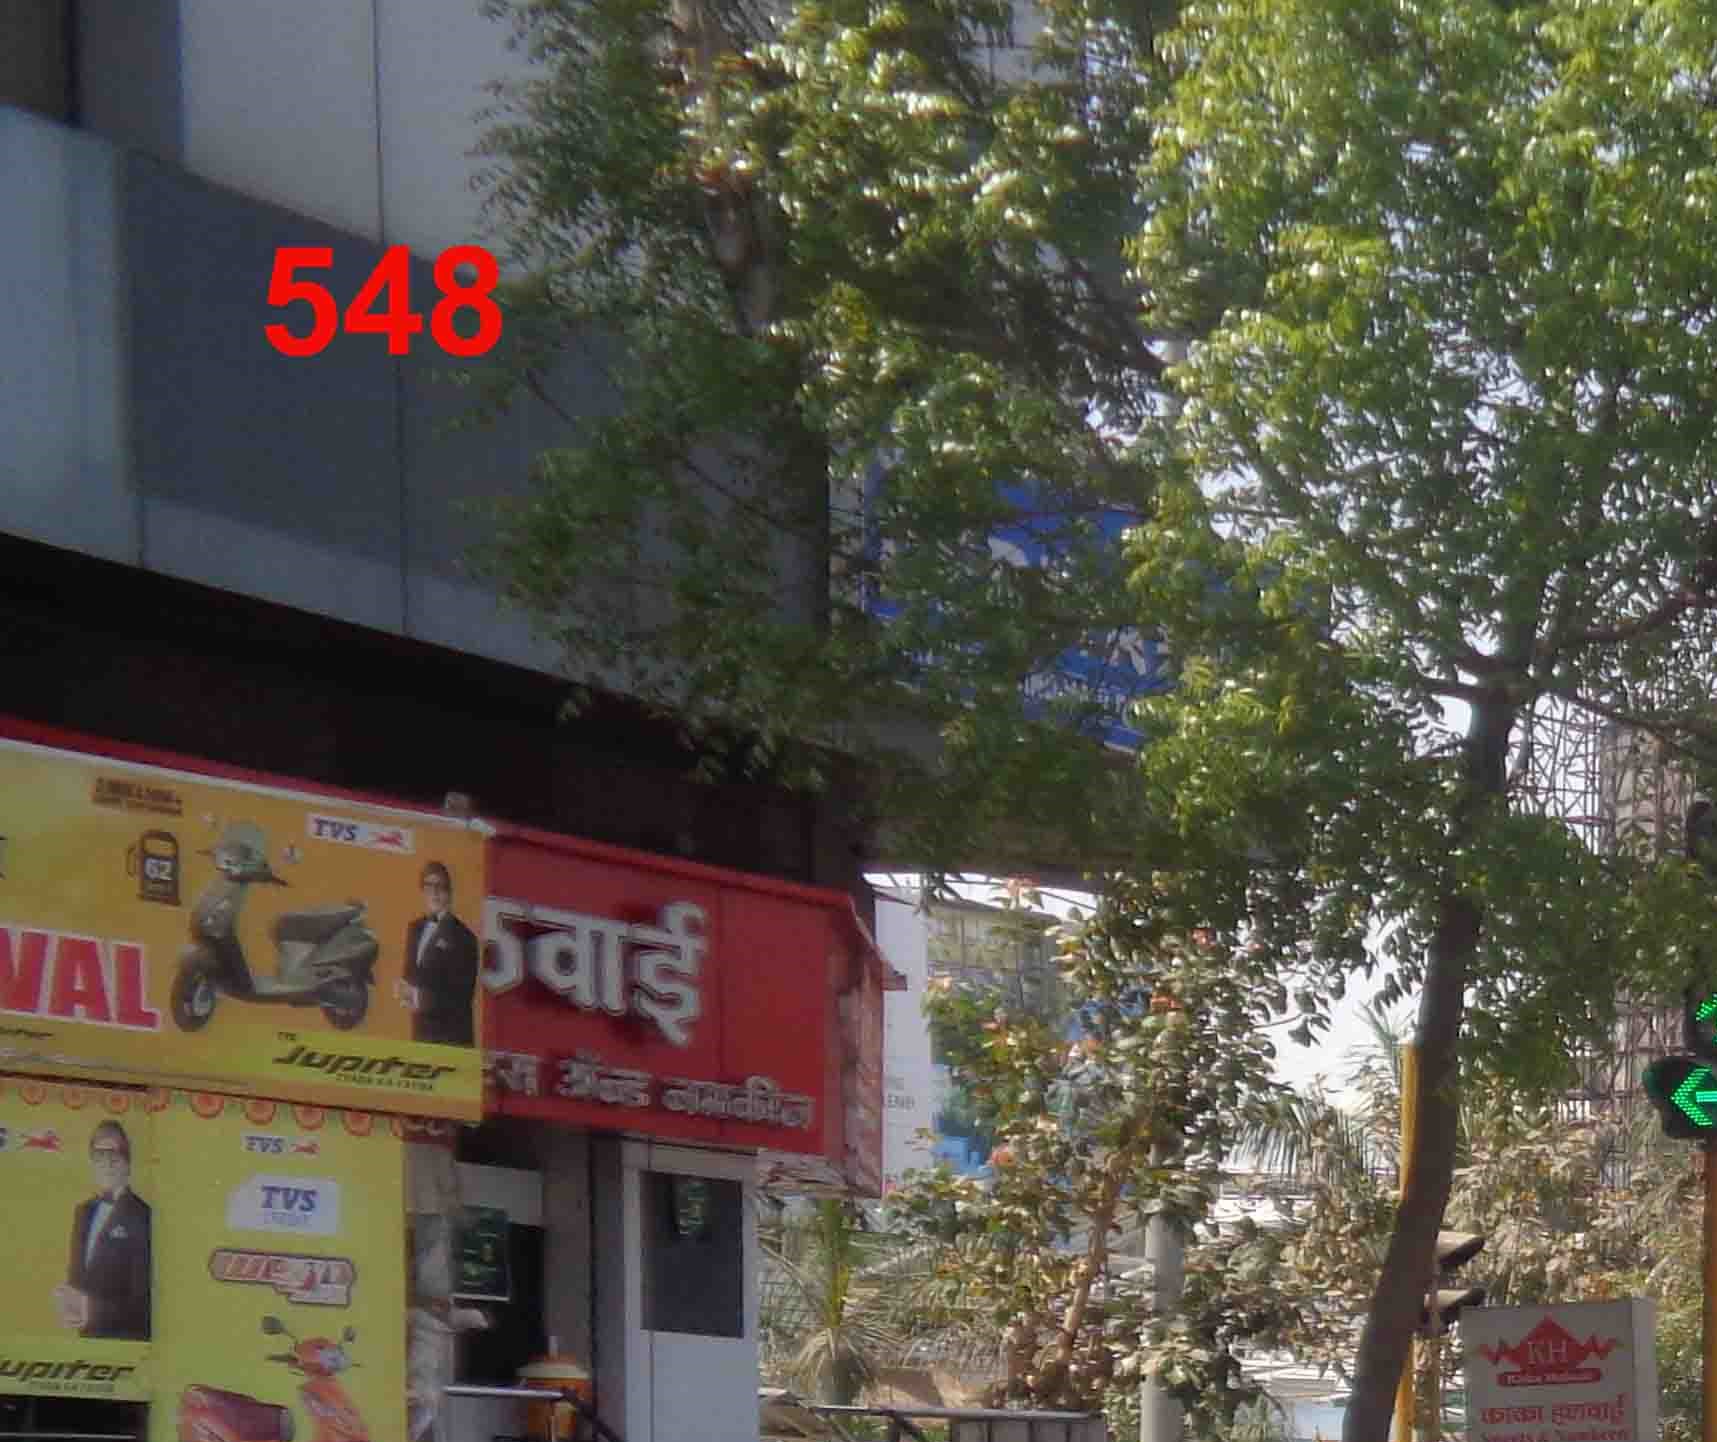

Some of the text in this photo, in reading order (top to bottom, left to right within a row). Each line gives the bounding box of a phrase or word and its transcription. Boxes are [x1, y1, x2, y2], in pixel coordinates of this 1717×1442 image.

[312, 816, 358, 841] TVS
[145, 857, 173, 881] 62
[272, 1044, 456, 1080] Jupiter
[245, 1135, 285, 1153] TVS
[261, 1185, 318, 1212] TVS
